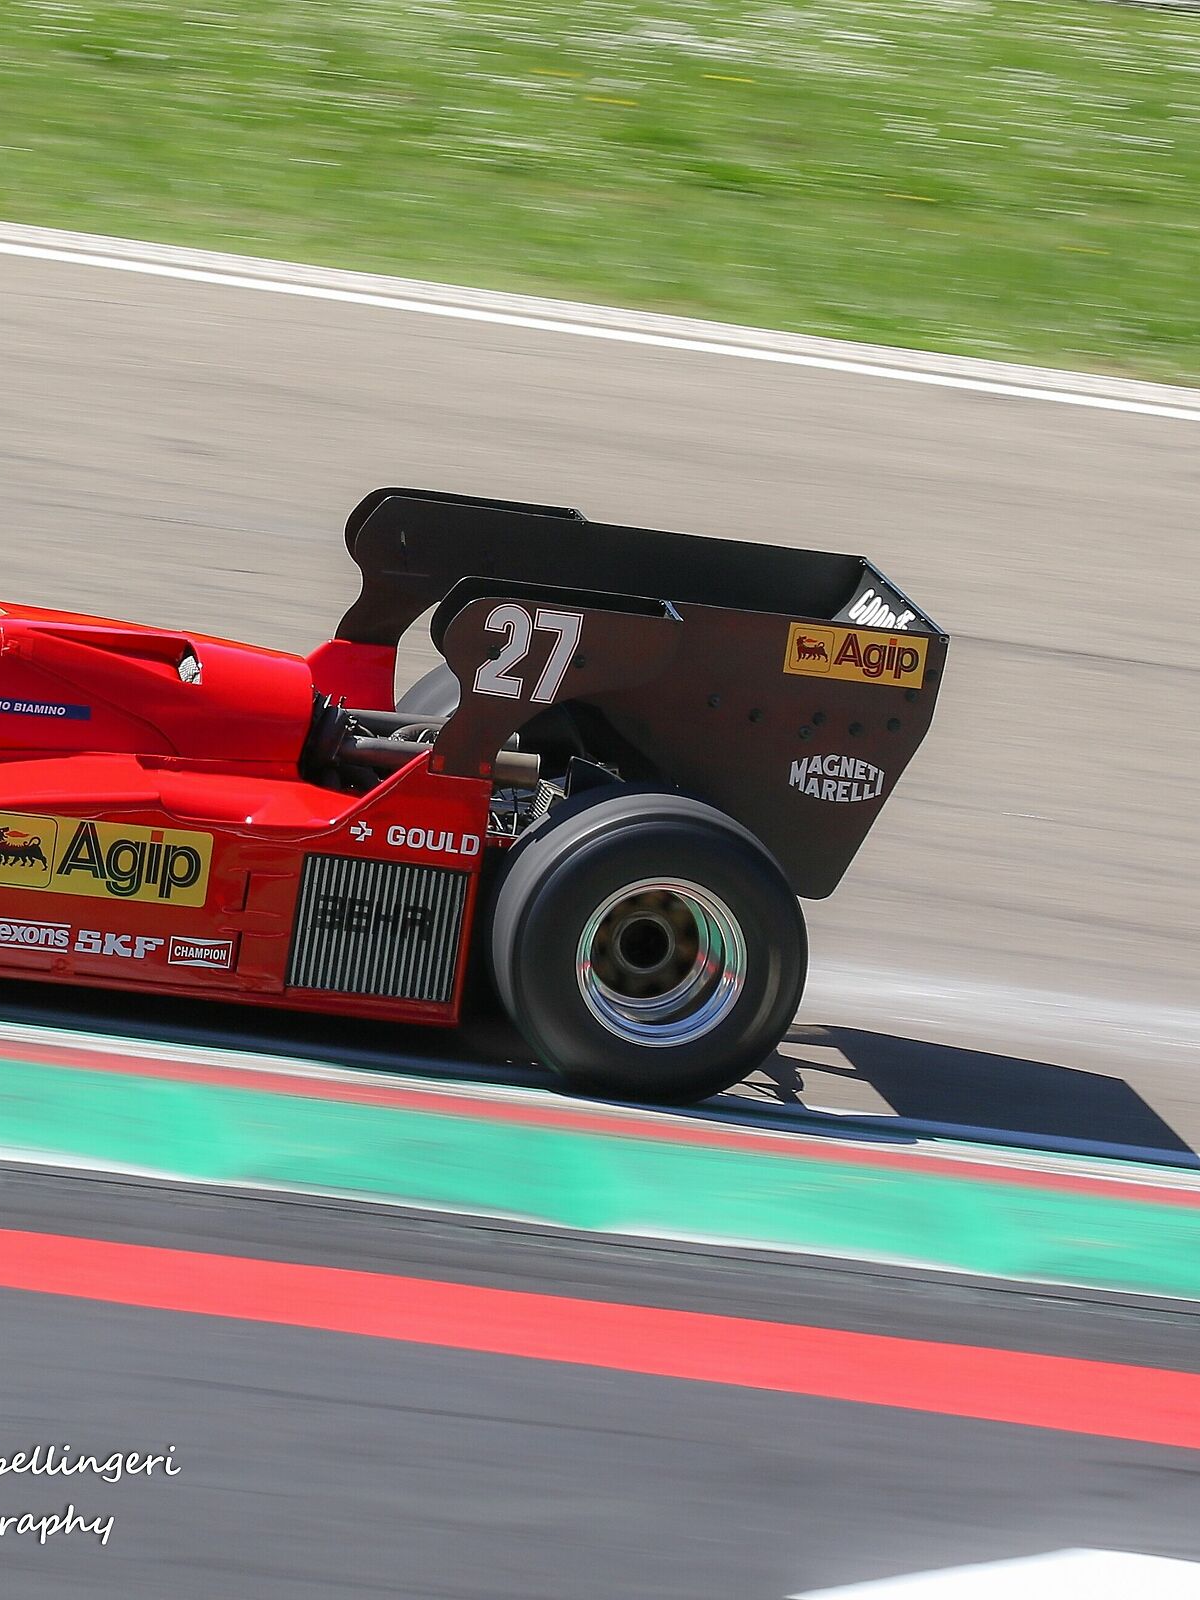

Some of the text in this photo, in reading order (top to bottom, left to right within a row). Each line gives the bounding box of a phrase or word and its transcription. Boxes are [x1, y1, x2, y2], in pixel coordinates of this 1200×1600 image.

[472, 603, 585, 705] 27
[833, 632, 920, 679] Agip
[13, 702, 66, 716] BIAMINO
[788, 754, 885, 790] MAGNETI
[788, 771, 885, 802] MARELLI
[386, 825, 481, 856] GOULD
[56, 820, 202, 899] Agip
[315, 894, 432, 941] BEHR
[74, 929, 165, 959] SKF
[174, 945, 227, 961] CHAMPION
